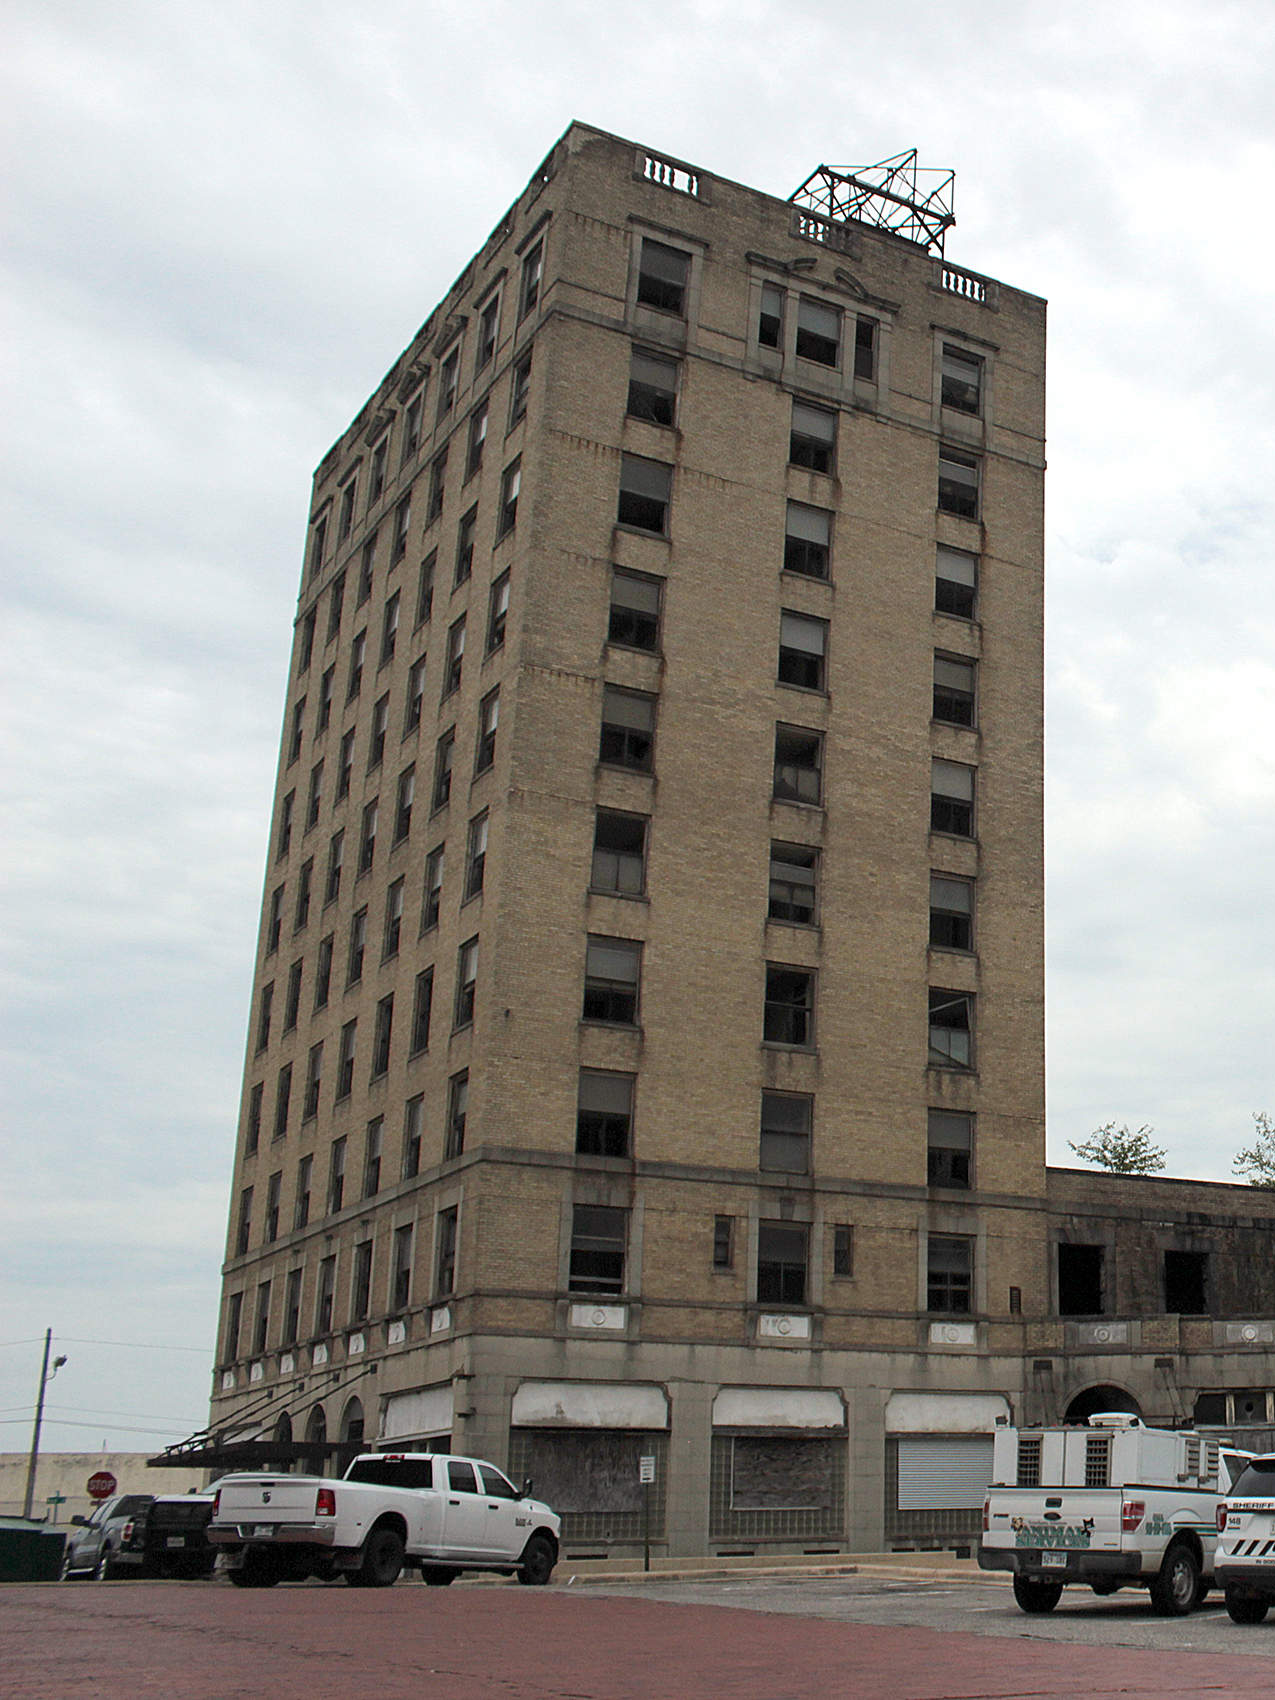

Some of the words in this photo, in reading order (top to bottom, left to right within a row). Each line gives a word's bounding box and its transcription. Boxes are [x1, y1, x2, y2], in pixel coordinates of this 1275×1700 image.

[88, 1479, 115, 1491] STOP
[1228, 1517, 1242, 1525] 148
[1015, 1536, 1091, 1548] SERVICES
